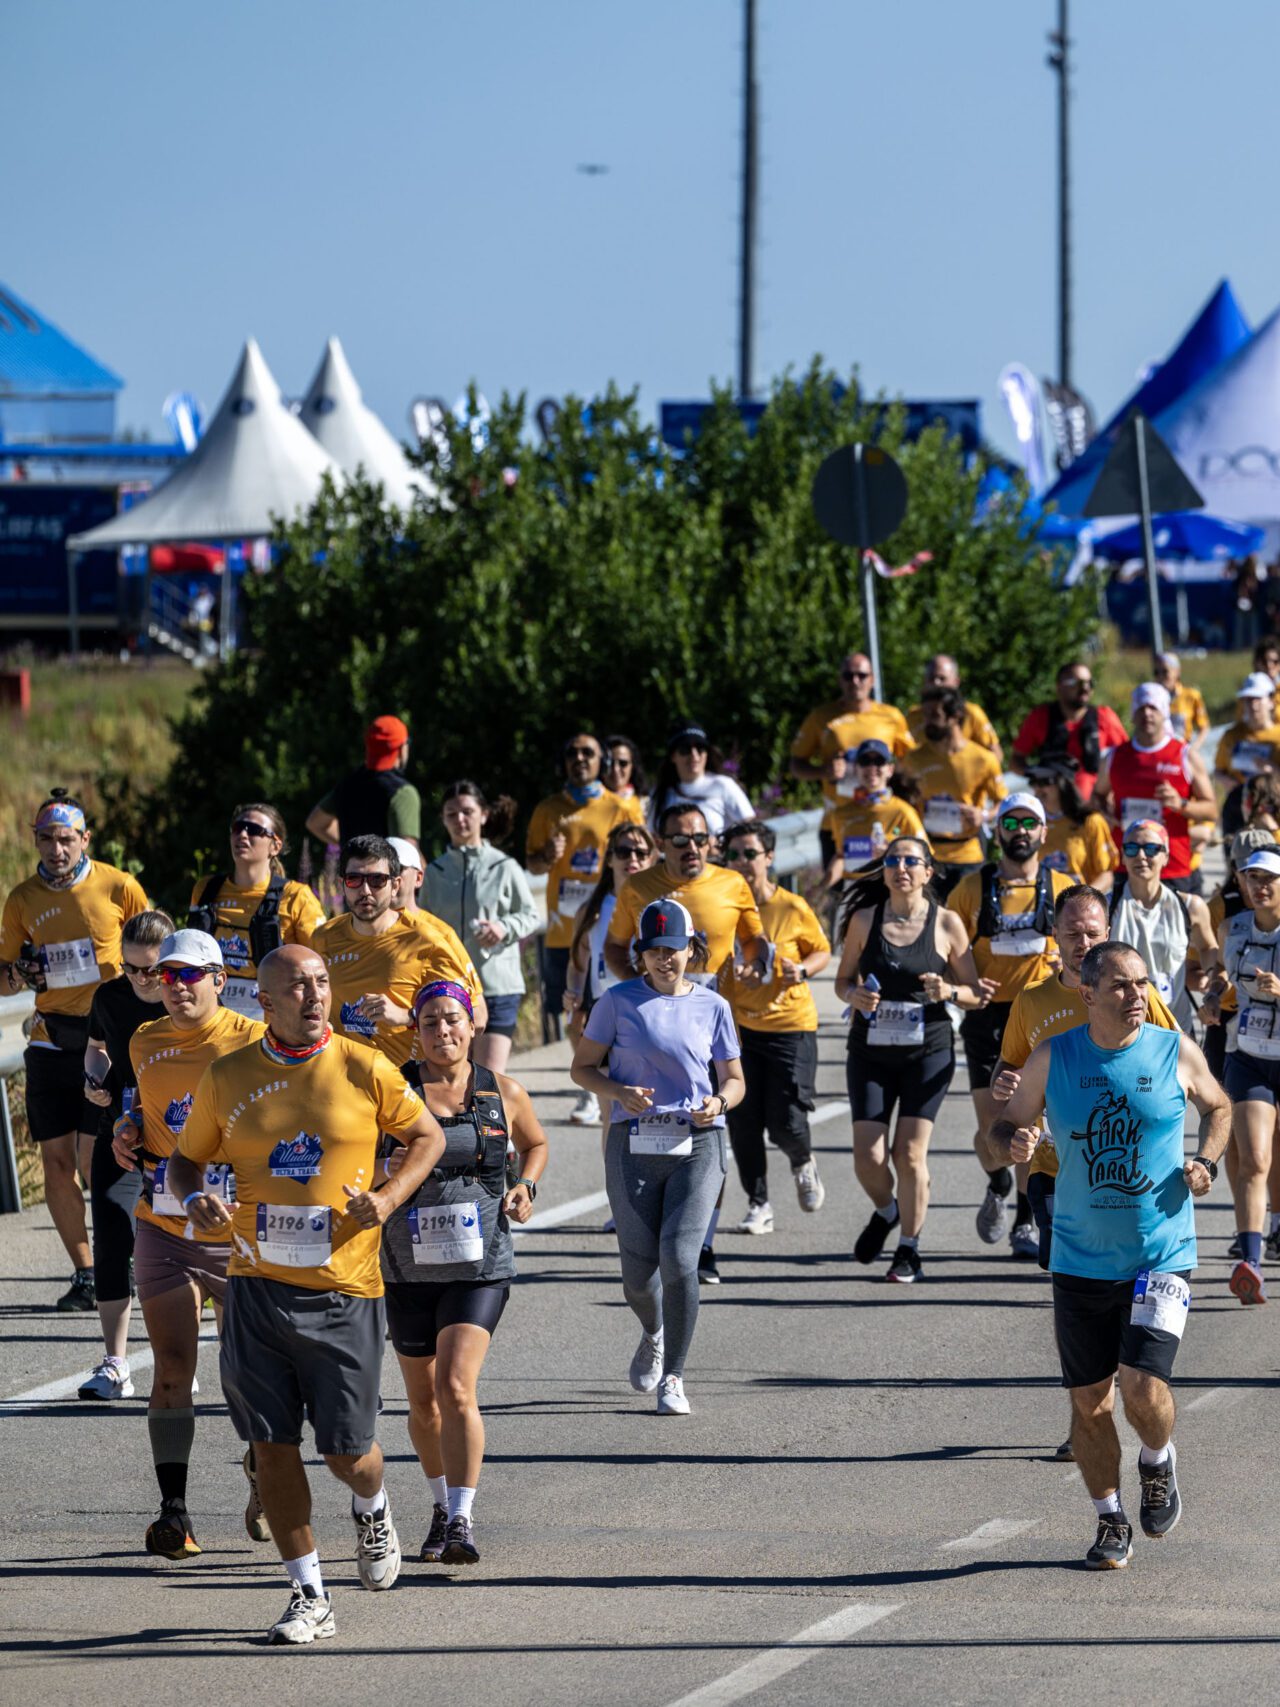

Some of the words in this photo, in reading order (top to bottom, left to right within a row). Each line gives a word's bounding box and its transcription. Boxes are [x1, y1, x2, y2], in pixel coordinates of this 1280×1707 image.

[49, 949, 74, 962] 2135
[268, 1215, 305, 1231] 2196
[421, 1214, 456, 1231] 2194
[1148, 1281, 1182, 1299] 2403
